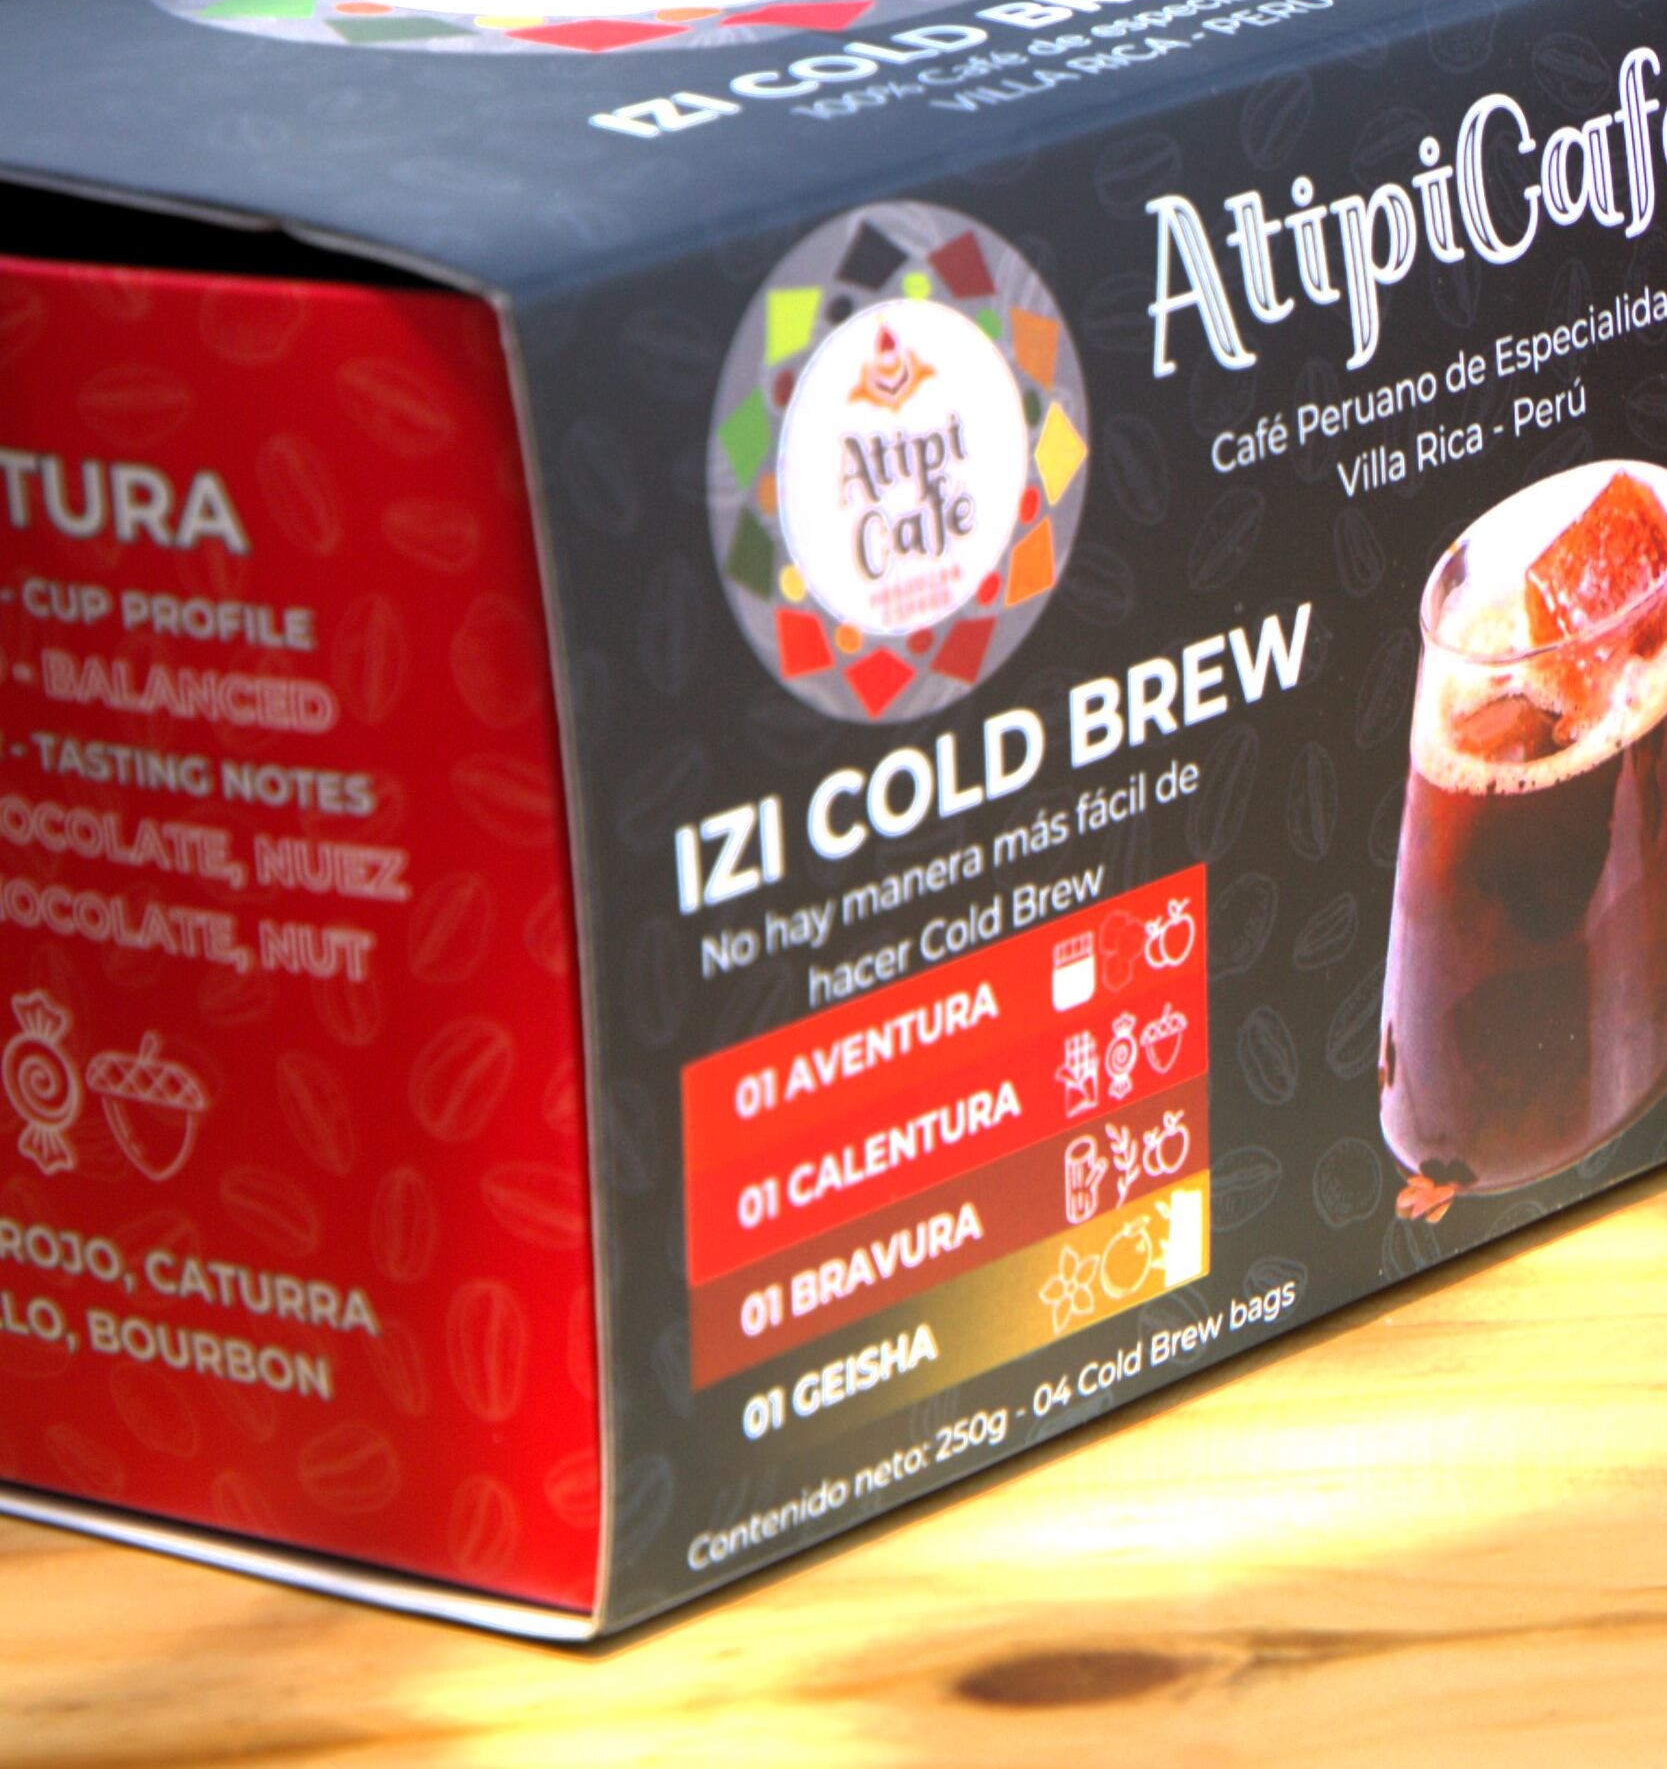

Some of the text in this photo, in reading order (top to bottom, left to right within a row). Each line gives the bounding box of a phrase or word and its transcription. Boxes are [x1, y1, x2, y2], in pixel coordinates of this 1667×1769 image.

[589, 91, 741, 139] IZI
[731, 24, 989, 98] COLD
[790, 80, 925, 121] 100%
[917, 46, 1029, 84] Café
[1028, 32, 1090, 56] de
[930, 67, 1081, 112] VILLA
[1067, 37, 1192, 75] RICA
[839, 413, 967, 509] Atipi
[1211, 413, 1289, 474] Café
[1297, 374, 1437, 446] Peruano
[1445, 349, 1487, 394] de
[1336, 442, 1406, 497] Villa
[1417, 419, 1483, 471] Rica
[1513, 377, 1587, 436] Perú
[0, 447, 250, 557] TURA
[21, 577, 112, 623] CUP
[121, 590, 316, 652] PROFILE
[41, 648, 338, 734] BALANCED
[32, 732, 210, 797] TASTING
[219, 760, 378, 817] NOTES
[674, 602, 1311, 915] IZI COLD BREW
[0, 793, 411, 903] OCOLATE, NUEZ
[701, 760, 1199, 979] No hay manera más fácil de
[0, 877, 378, 983] OCOLATE, NUT
[808, 865, 1105, 1008] hacer Cold Brew
[735, 982, 999, 1120] 01 AVENTURA
[737, 1081, 1021, 1229] 01 CALENTURA
[144, 1250, 380, 1336] CATURRA
[741, 1203, 983, 1336] 01 BRAVURA
[86, 1310, 335, 1401] BOURBON
[742, 1324, 939, 1440] 01 GEISHA
[687, 1473, 848, 1570] Contenido
[854, 1443, 931, 1501] neto:
[935, 1406, 1008, 1463] 250g
[1033, 1382, 1072, 1420] 04
[1077, 1344, 1142, 1397] Cold
[1150, 1307, 1222, 1362] Brew
[1229, 1279, 1297, 1334] bags
